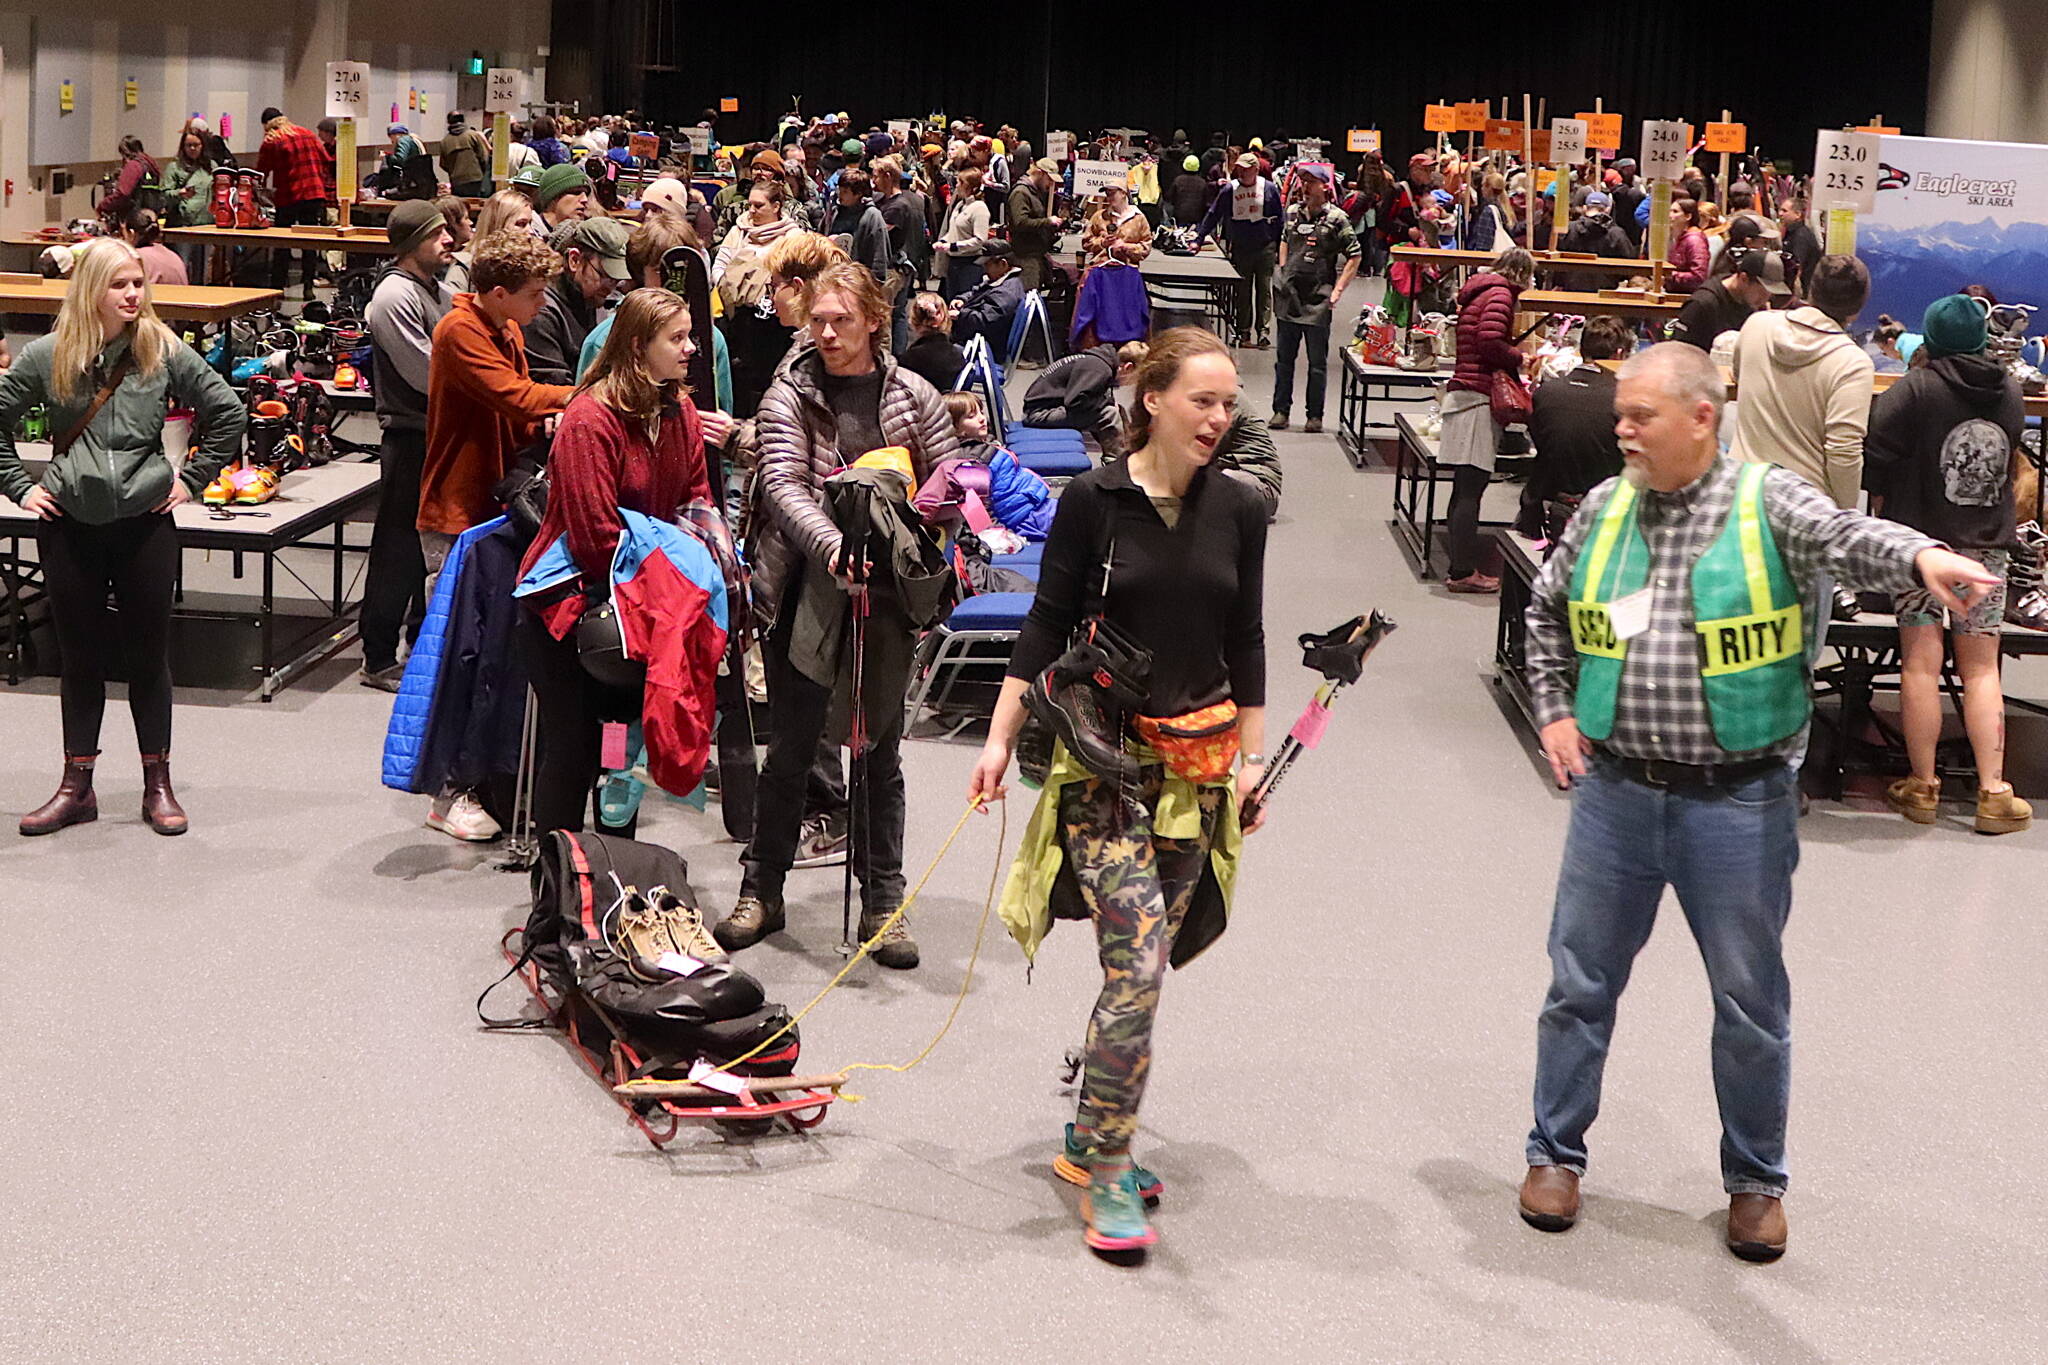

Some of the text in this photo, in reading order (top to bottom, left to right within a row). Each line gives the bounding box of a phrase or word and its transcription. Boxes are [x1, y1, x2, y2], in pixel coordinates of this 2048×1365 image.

[335, 71, 361, 83] 27.0
[493, 75, 513, 84] 26.0
[335, 91, 361, 102] 27.5
[493, 91, 513, 100] 26.5
[1558, 125, 1579, 135] 25.0
[1652, 130, 1679, 142] 24.0
[1556, 140, 1578, 151] 25.5
[1651, 150, 1677, 162] 24.5
[1829, 144, 1867, 163] 23.0
[1076, 166, 1127, 178] SNOWBOARDS
[1086, 179, 1105, 187] SMA
[1826, 172, 1864, 191] 23.5
[1914, 171, 2017, 198] Eaglecrest
[1967, 195, 2014, 208] SKI AREA
